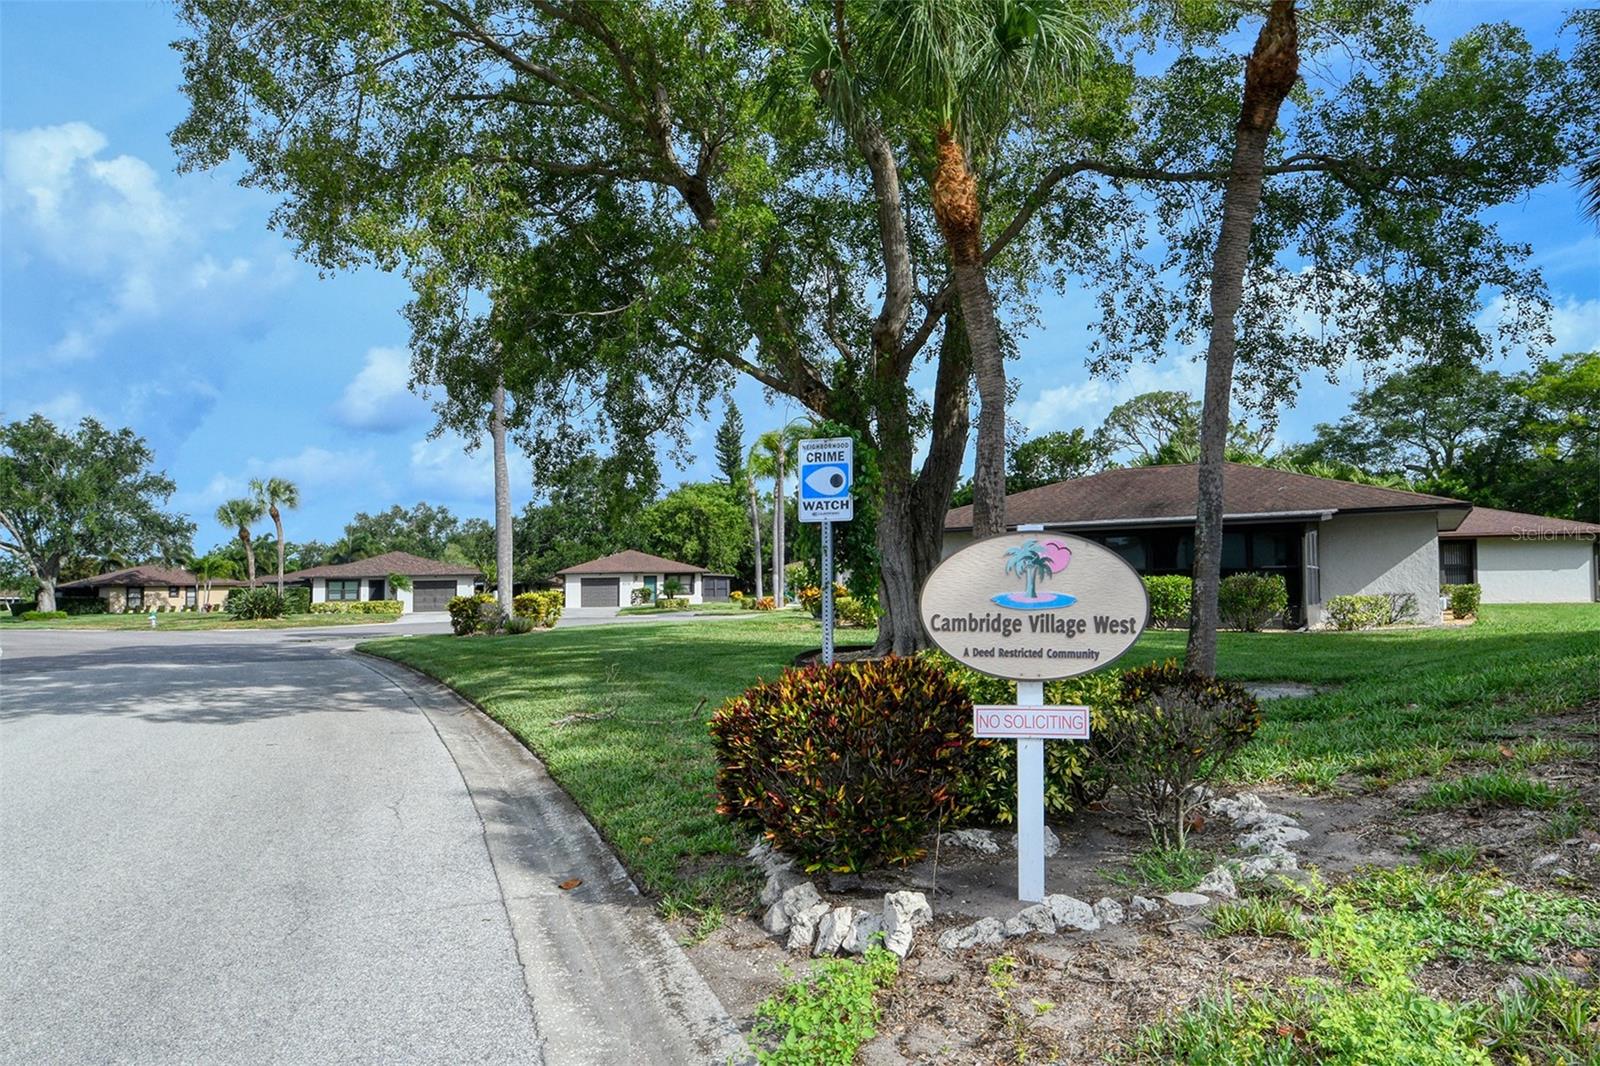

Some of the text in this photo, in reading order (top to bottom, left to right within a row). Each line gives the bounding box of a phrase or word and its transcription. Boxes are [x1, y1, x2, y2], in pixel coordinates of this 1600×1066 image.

[806, 451, 845, 463] CRIME
[802, 500, 849, 511] WATCH
[930, 613, 1136, 638] Cambridge Village West
[963, 648, 1100, 661] A Deed Restricted Community
[979, 714, 1084, 729] NO SOLICITING
